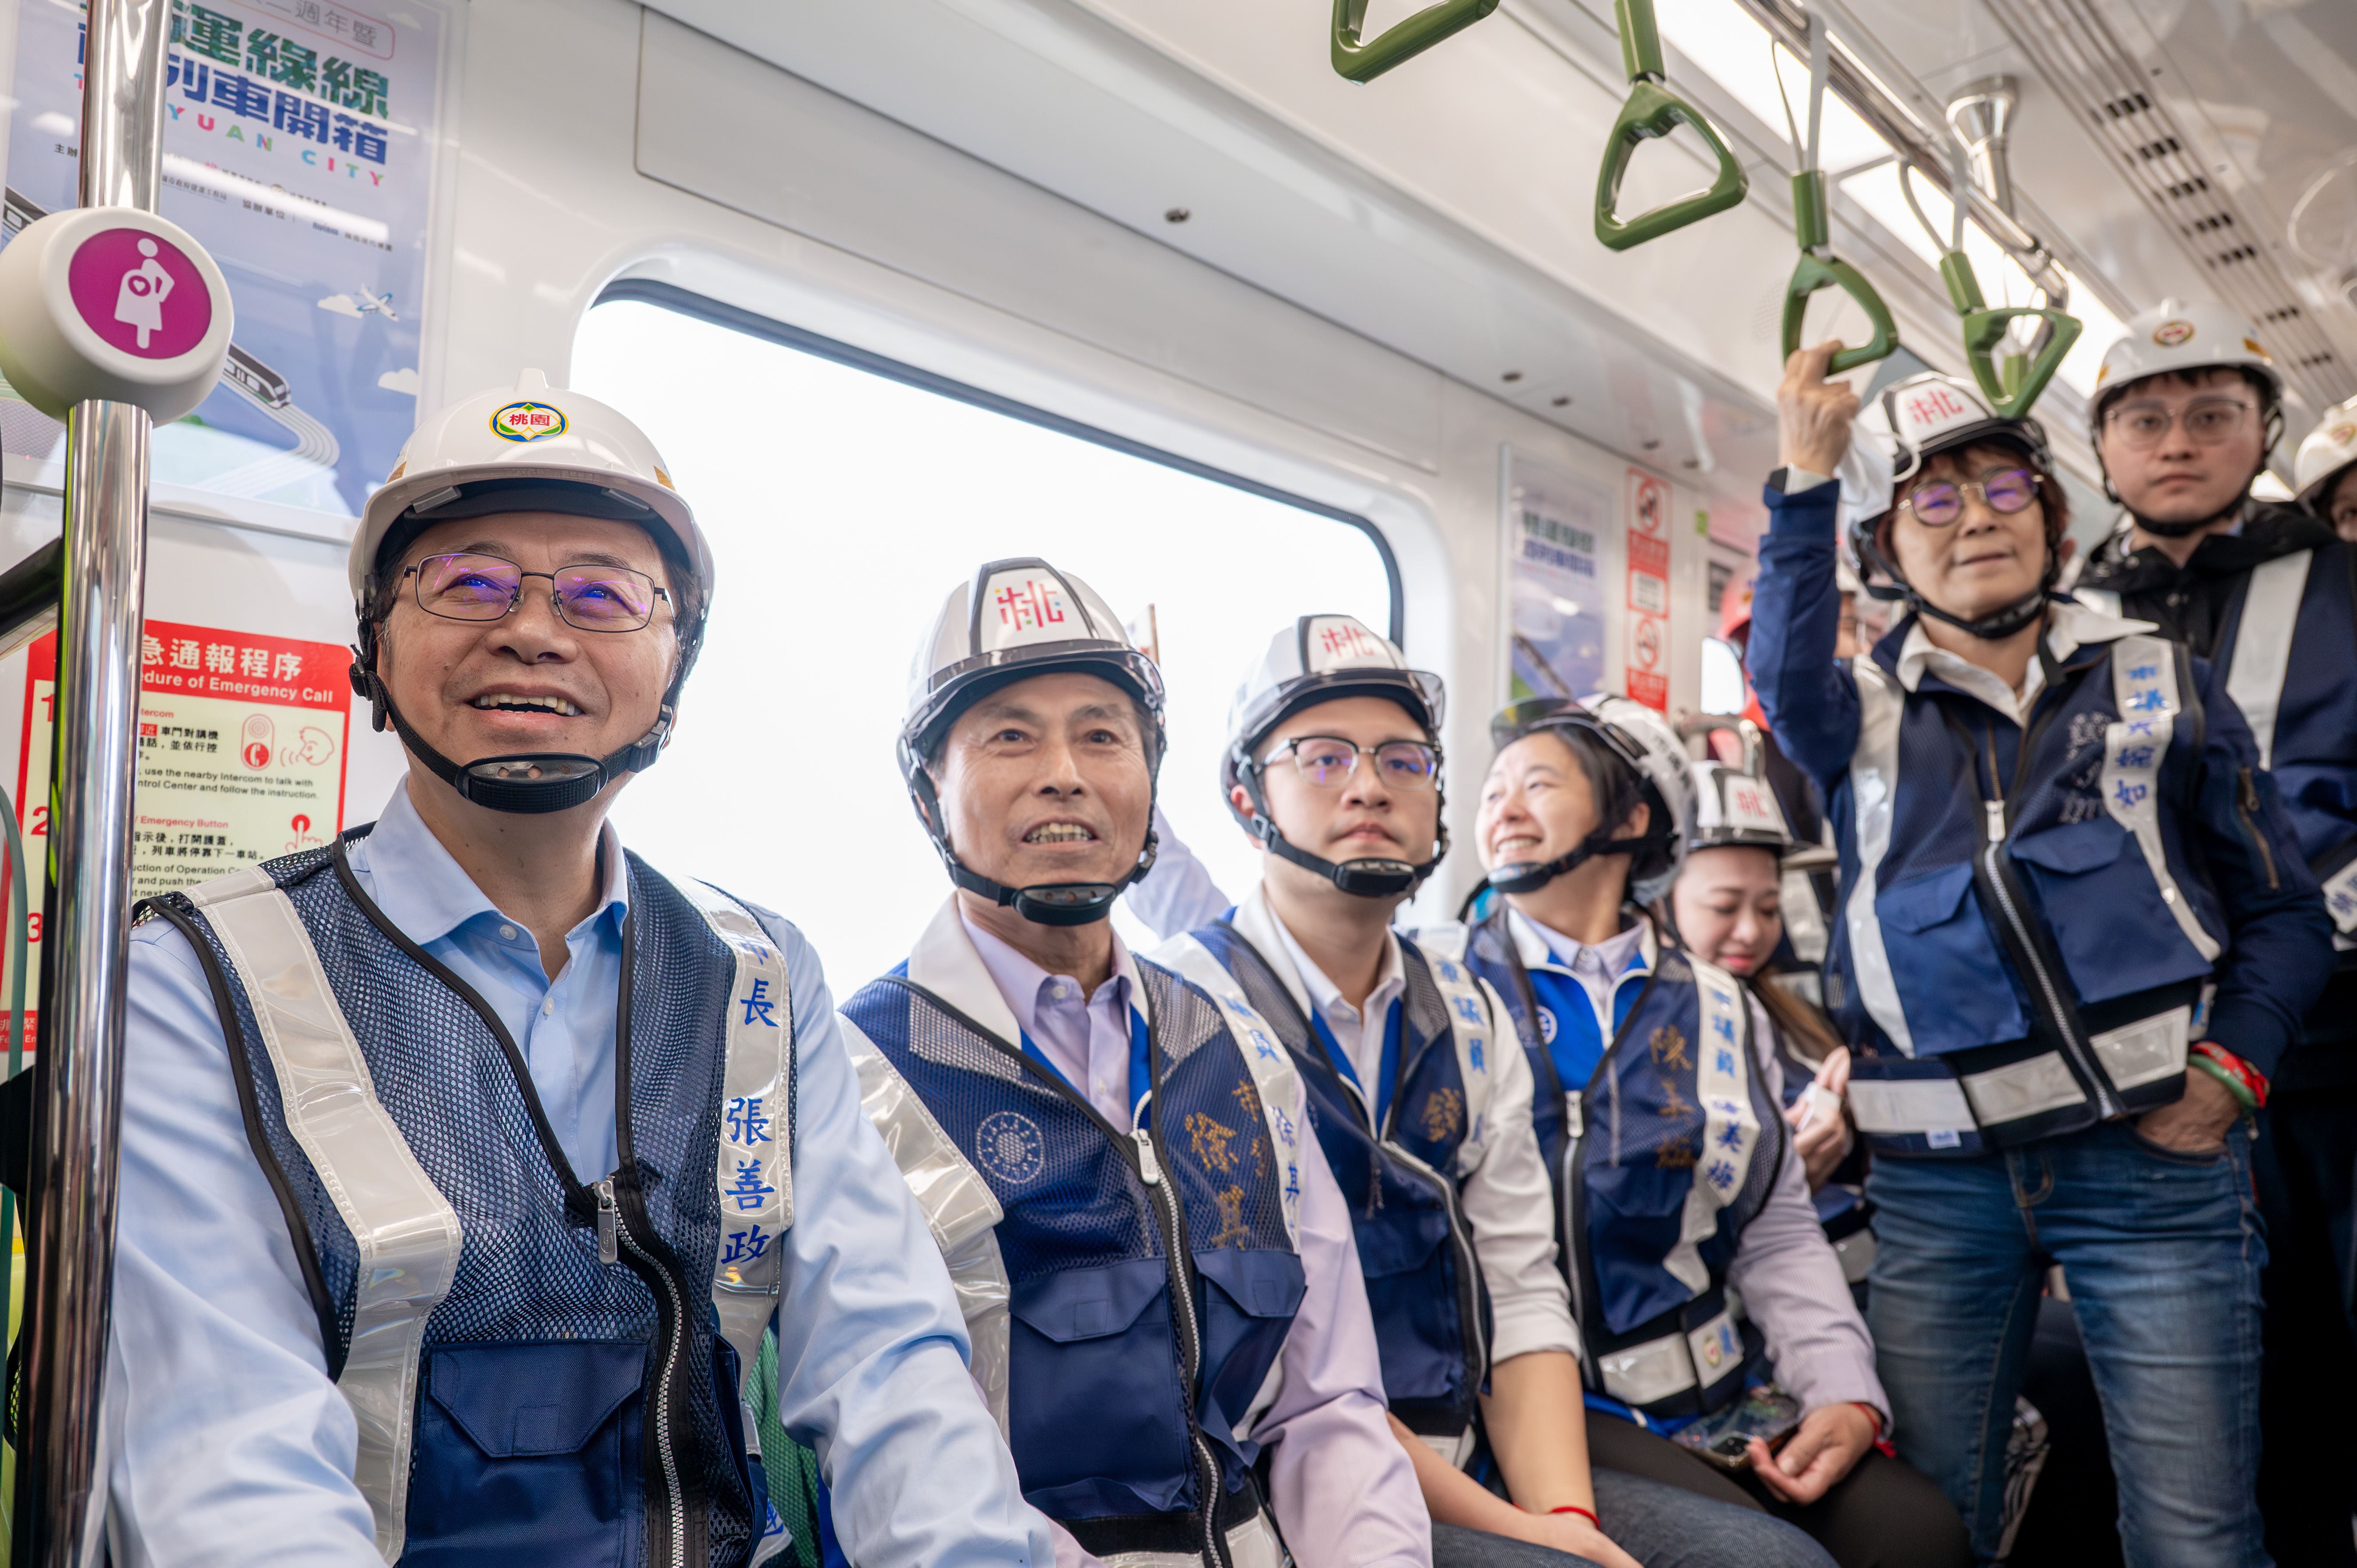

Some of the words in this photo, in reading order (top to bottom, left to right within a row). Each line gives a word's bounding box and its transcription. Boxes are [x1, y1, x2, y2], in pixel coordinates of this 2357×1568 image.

[256, 0, 377, 49] 一週年暨
[301, 149, 384, 187] CITY
[509, 413, 550, 427] 桃園
[1907, 388, 1965, 426] 桃
[995, 580, 1065, 631] 桃
[1318, 624, 1375, 658] 桃
[141, 670, 183, 687] dure
[188, 675, 204, 688] of
[209, 677, 298, 701] Emergency
[302, 686, 333, 704] Call
[163, 780, 197, 790] Center
[199, 784, 217, 793] and
[220, 785, 248, 794] follow
[166, 768, 182, 777] the
[184, 770, 217, 782] nearby
[220, 772, 262, 783] Intercom
[276, 777, 292, 785] talk
[30, 806, 50, 836] 2
[140, 815, 195, 828] Emergency
[197, 818, 229, 828] Button
[159, 877, 183, 886] push
[164, 864, 174, 872] of
[176, 864, 225, 875] Operation
[27, 913, 43, 942] 3
[721, 1097, 775, 1264] 張善政
